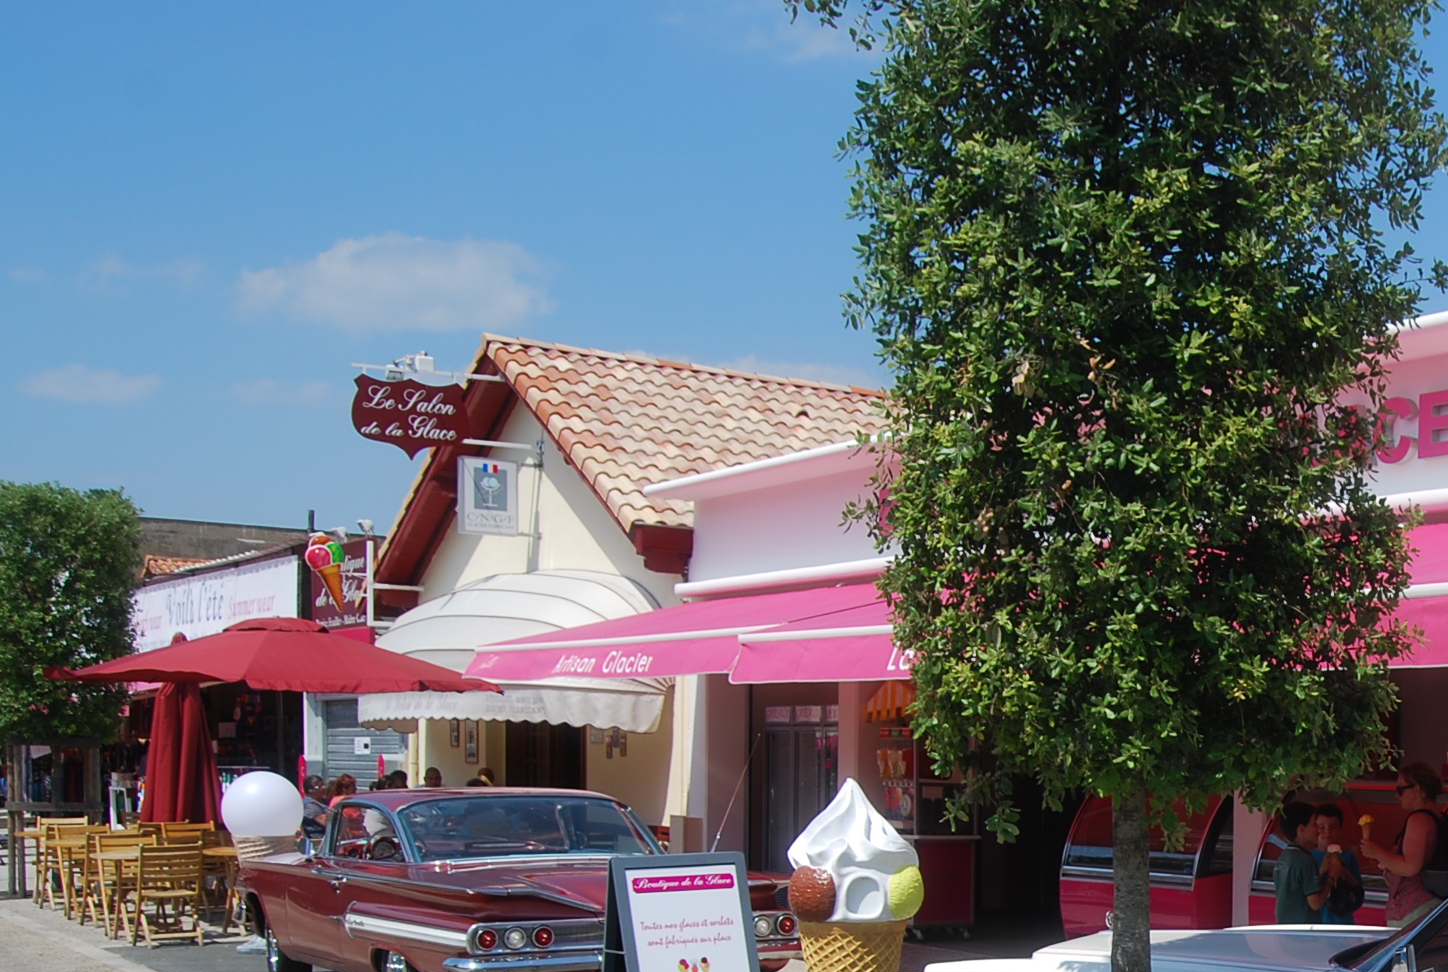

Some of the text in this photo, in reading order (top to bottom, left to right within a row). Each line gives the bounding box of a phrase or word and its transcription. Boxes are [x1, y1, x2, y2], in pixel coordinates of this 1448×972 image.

[362, 385, 456, 415] Le Salon
[360, 415, 457, 440] de la Glace
[315, 588, 327, 607] de
[552, 651, 653, 674] Artisan Glacier
[634, 875, 732, 890] Boutique de la Glace
[641, 921, 662, 931] Toutes
[679, 919, 699, 932] glaces
[701, 919, 708, 927] et
[710, 916, 734, 927] sorbets
[647, 938, 663, 946] sont
[665, 935, 698, 949] fabriqués
[713, 932, 732, 945] place
